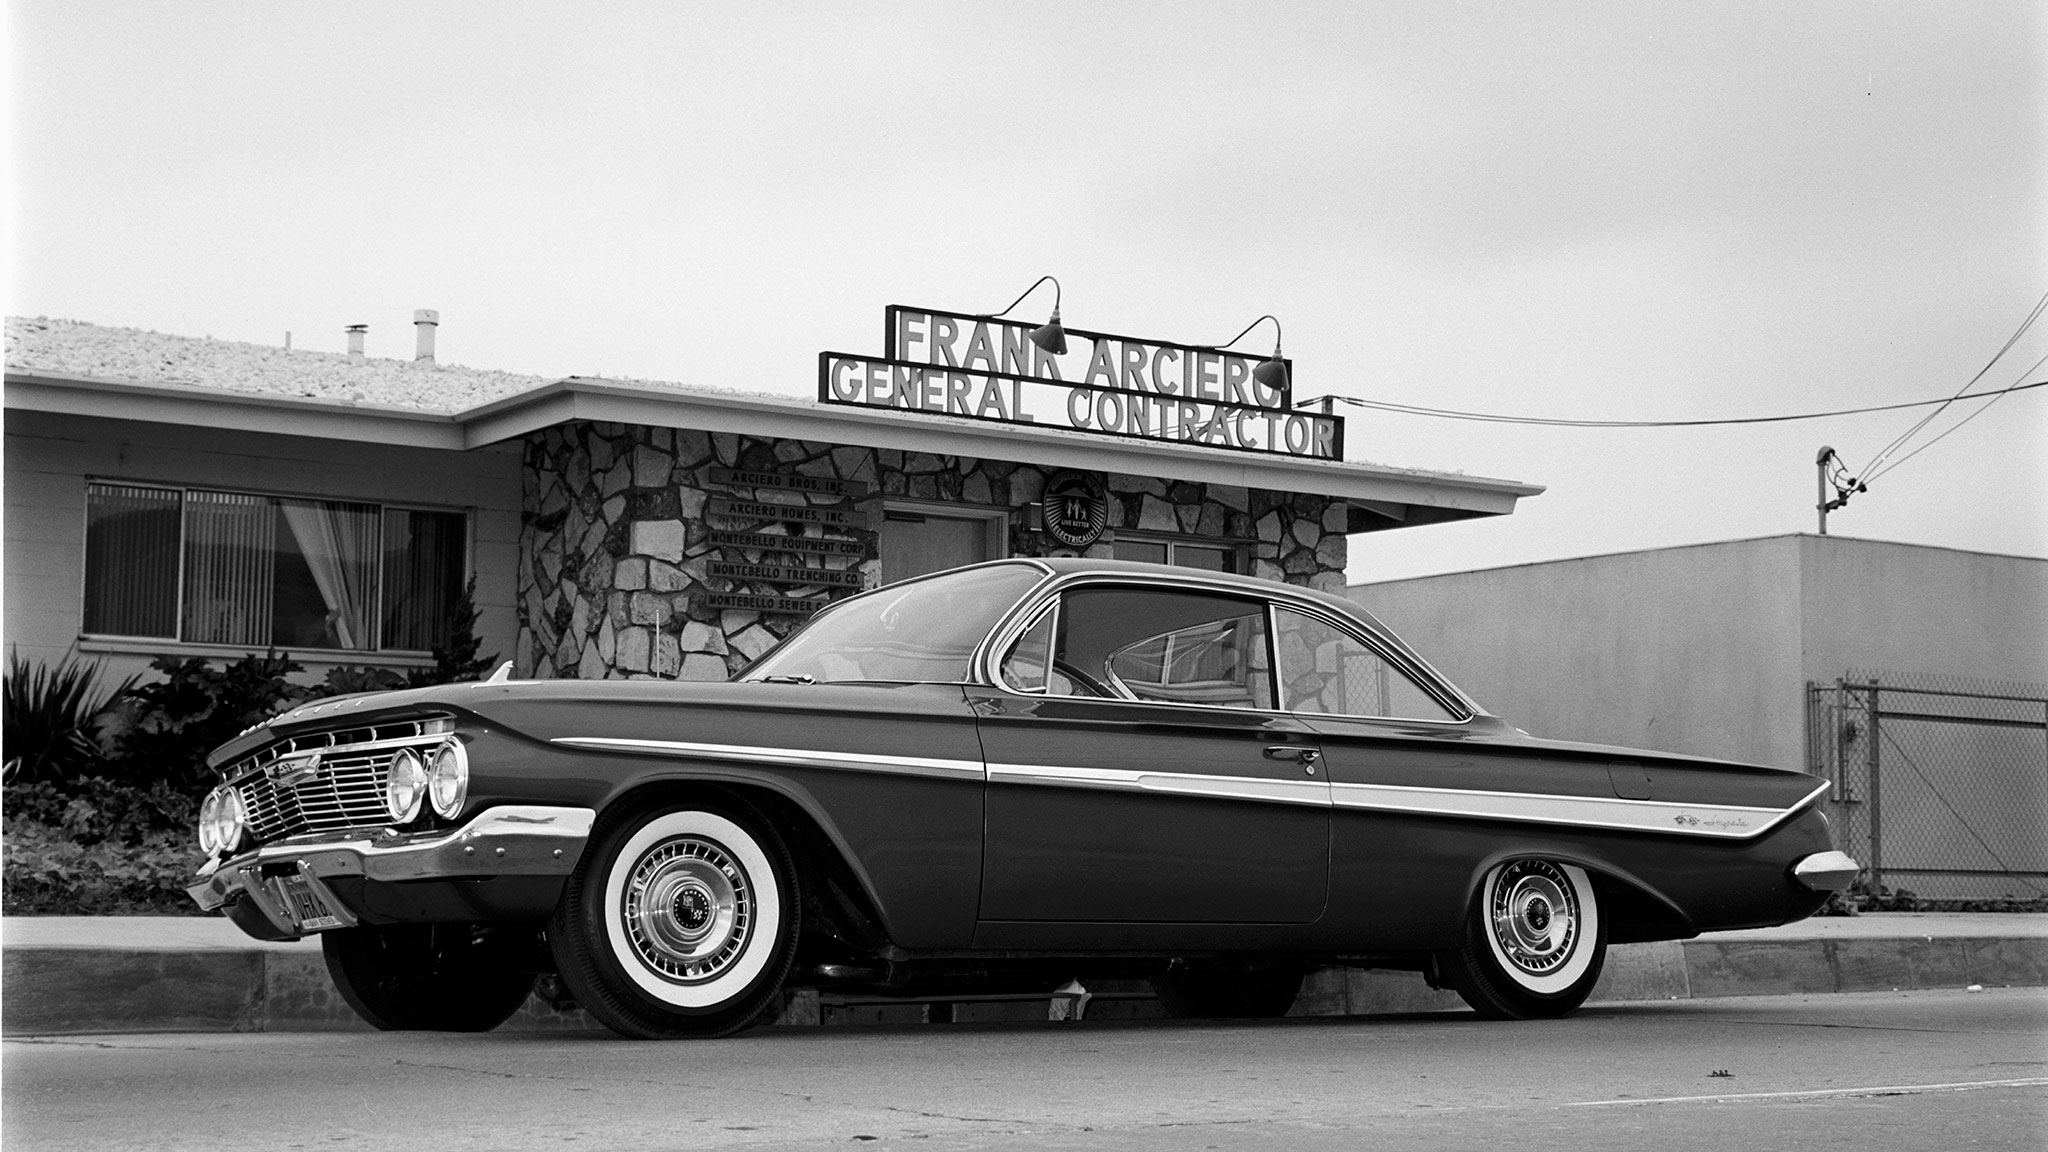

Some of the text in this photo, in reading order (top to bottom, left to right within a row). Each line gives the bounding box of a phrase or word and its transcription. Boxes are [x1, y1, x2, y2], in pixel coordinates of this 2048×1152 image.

[832, 358, 1334, 458] GENERAL CONTRACTOR
[731, 472, 782, 486] ARCIERO
[825, 481, 848, 493] INC.
[728, 503, 776, 517] ARCIERO
[825, 511, 849, 523] INC.
[1073, 520, 1090, 528] BETTER
[710, 532, 776, 548] MONTEBELLO
[781, 538, 836, 553] EQUIPMENT
[1053, 525, 1096, 544] ELECTRICALLY
[713, 563, 860, 585] MONTEBELLO TRENCHING CO.
[709, 593, 774, 609] MONTEBELLO
[779, 599, 812, 612] SEWER
